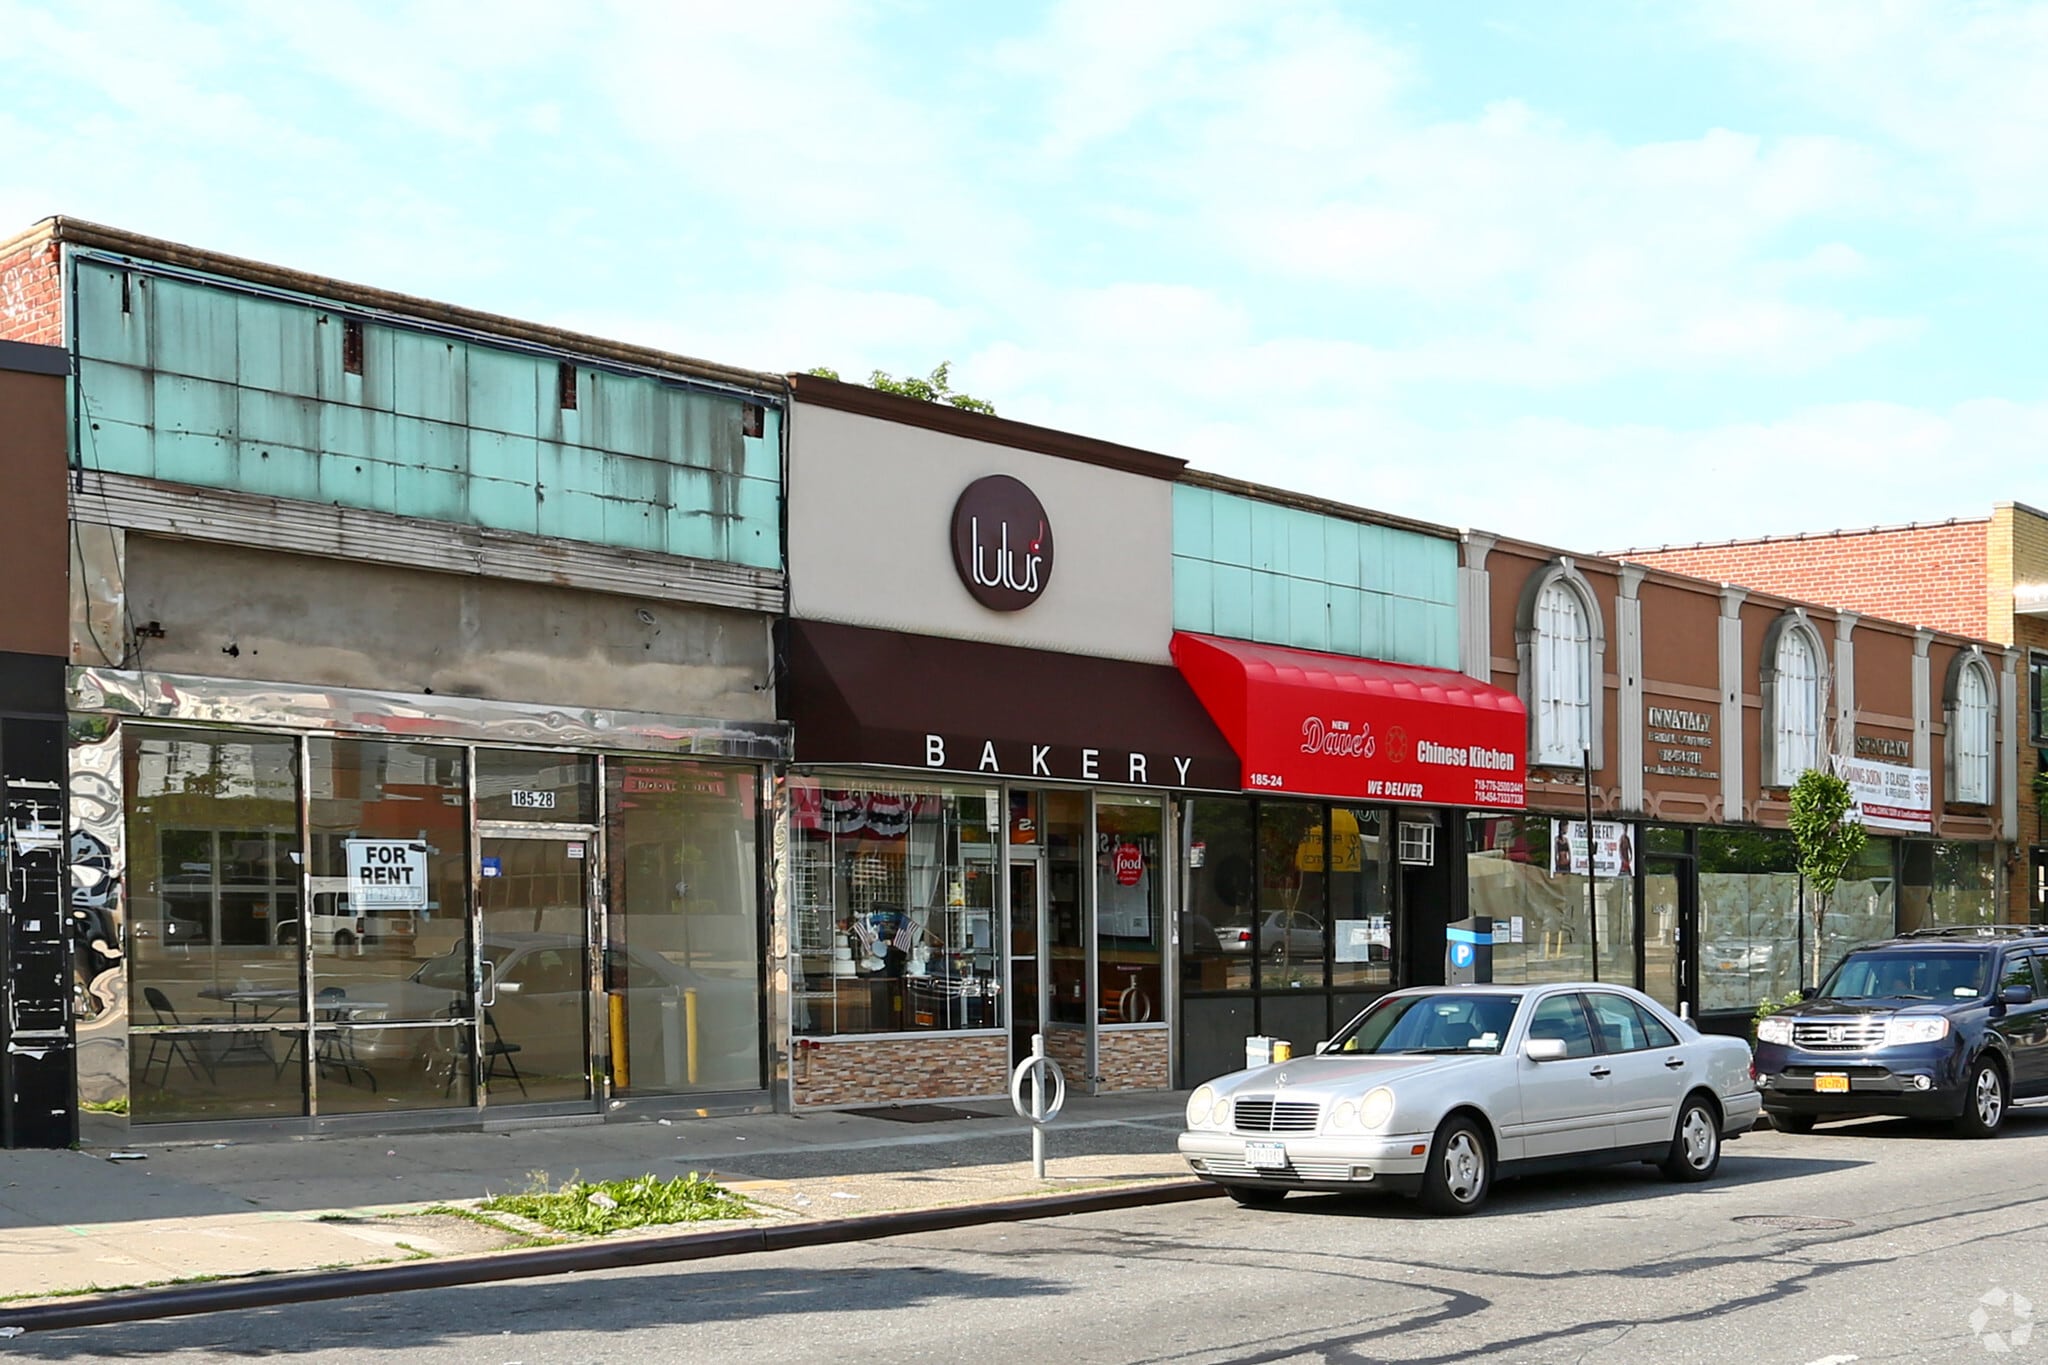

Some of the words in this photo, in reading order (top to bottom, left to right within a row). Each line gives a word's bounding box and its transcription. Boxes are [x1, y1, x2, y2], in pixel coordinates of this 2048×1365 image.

[1332, 720, 1349, 730] NEW
[1647, 706, 1712, 732] INNATALY
[1301, 716, 1375, 758] Dave's
[926, 734, 1192, 786] BAKERY
[1417, 740, 1467, 767] Chinese
[1469, 746, 1514, 771] Kitchen
[1251, 773, 1282, 787] 185-24
[1367, 780, 1382, 794] WE
[1385, 781, 1423, 798] DELIVER
[514, 791, 553, 807] 185-28
[1575, 823, 1588, 839] FIGH
[366, 846, 406, 865] FOR
[1117, 853, 1142, 876] food
[360, 866, 414, 885] RENT
[1457, 945, 1469, 964] P
